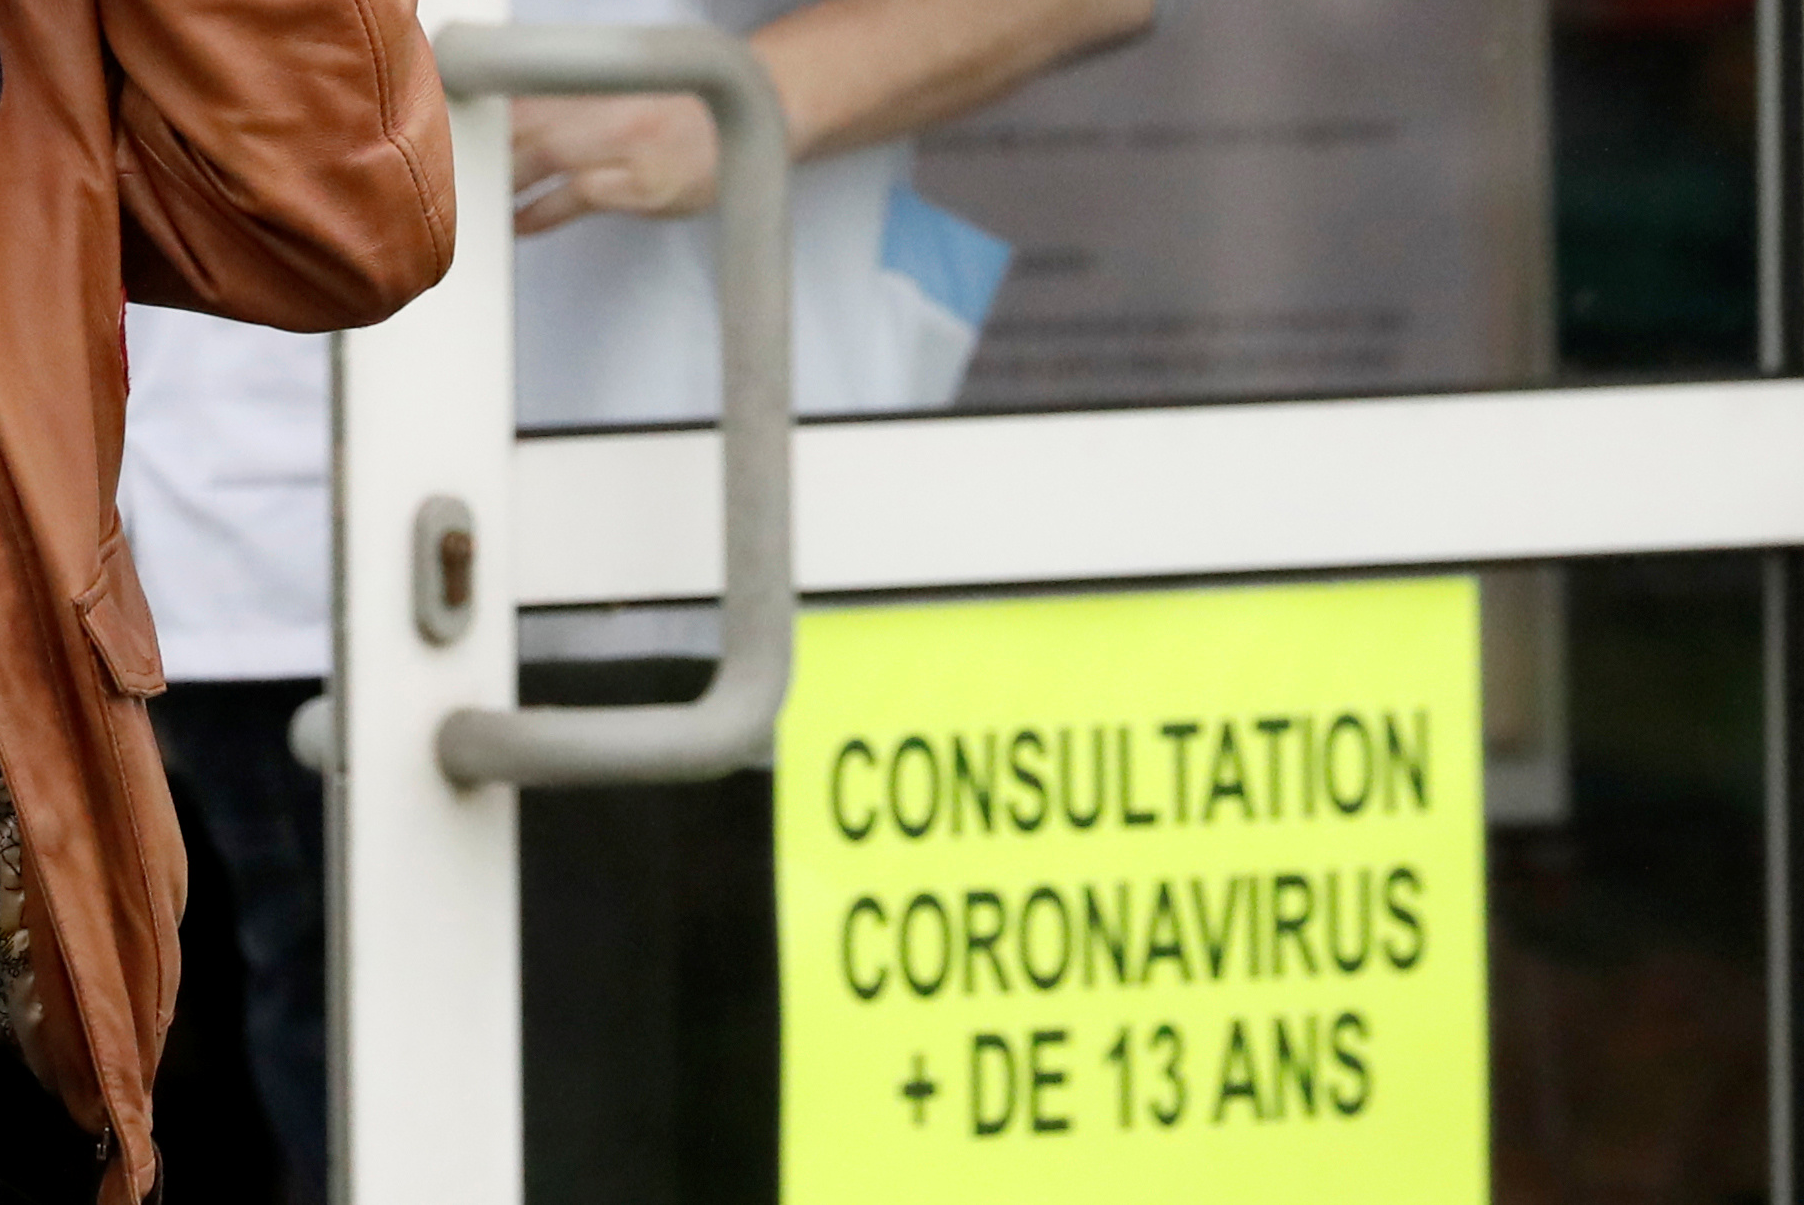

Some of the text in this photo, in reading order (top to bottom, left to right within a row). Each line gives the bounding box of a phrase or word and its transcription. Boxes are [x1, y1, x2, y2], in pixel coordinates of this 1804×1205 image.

[829, 710, 1432, 842] CONSULTATION
[841, 865, 1427, 1000] CORONAVIRUS
[900, 1011, 1373, 1138] + DE 13 ANS
